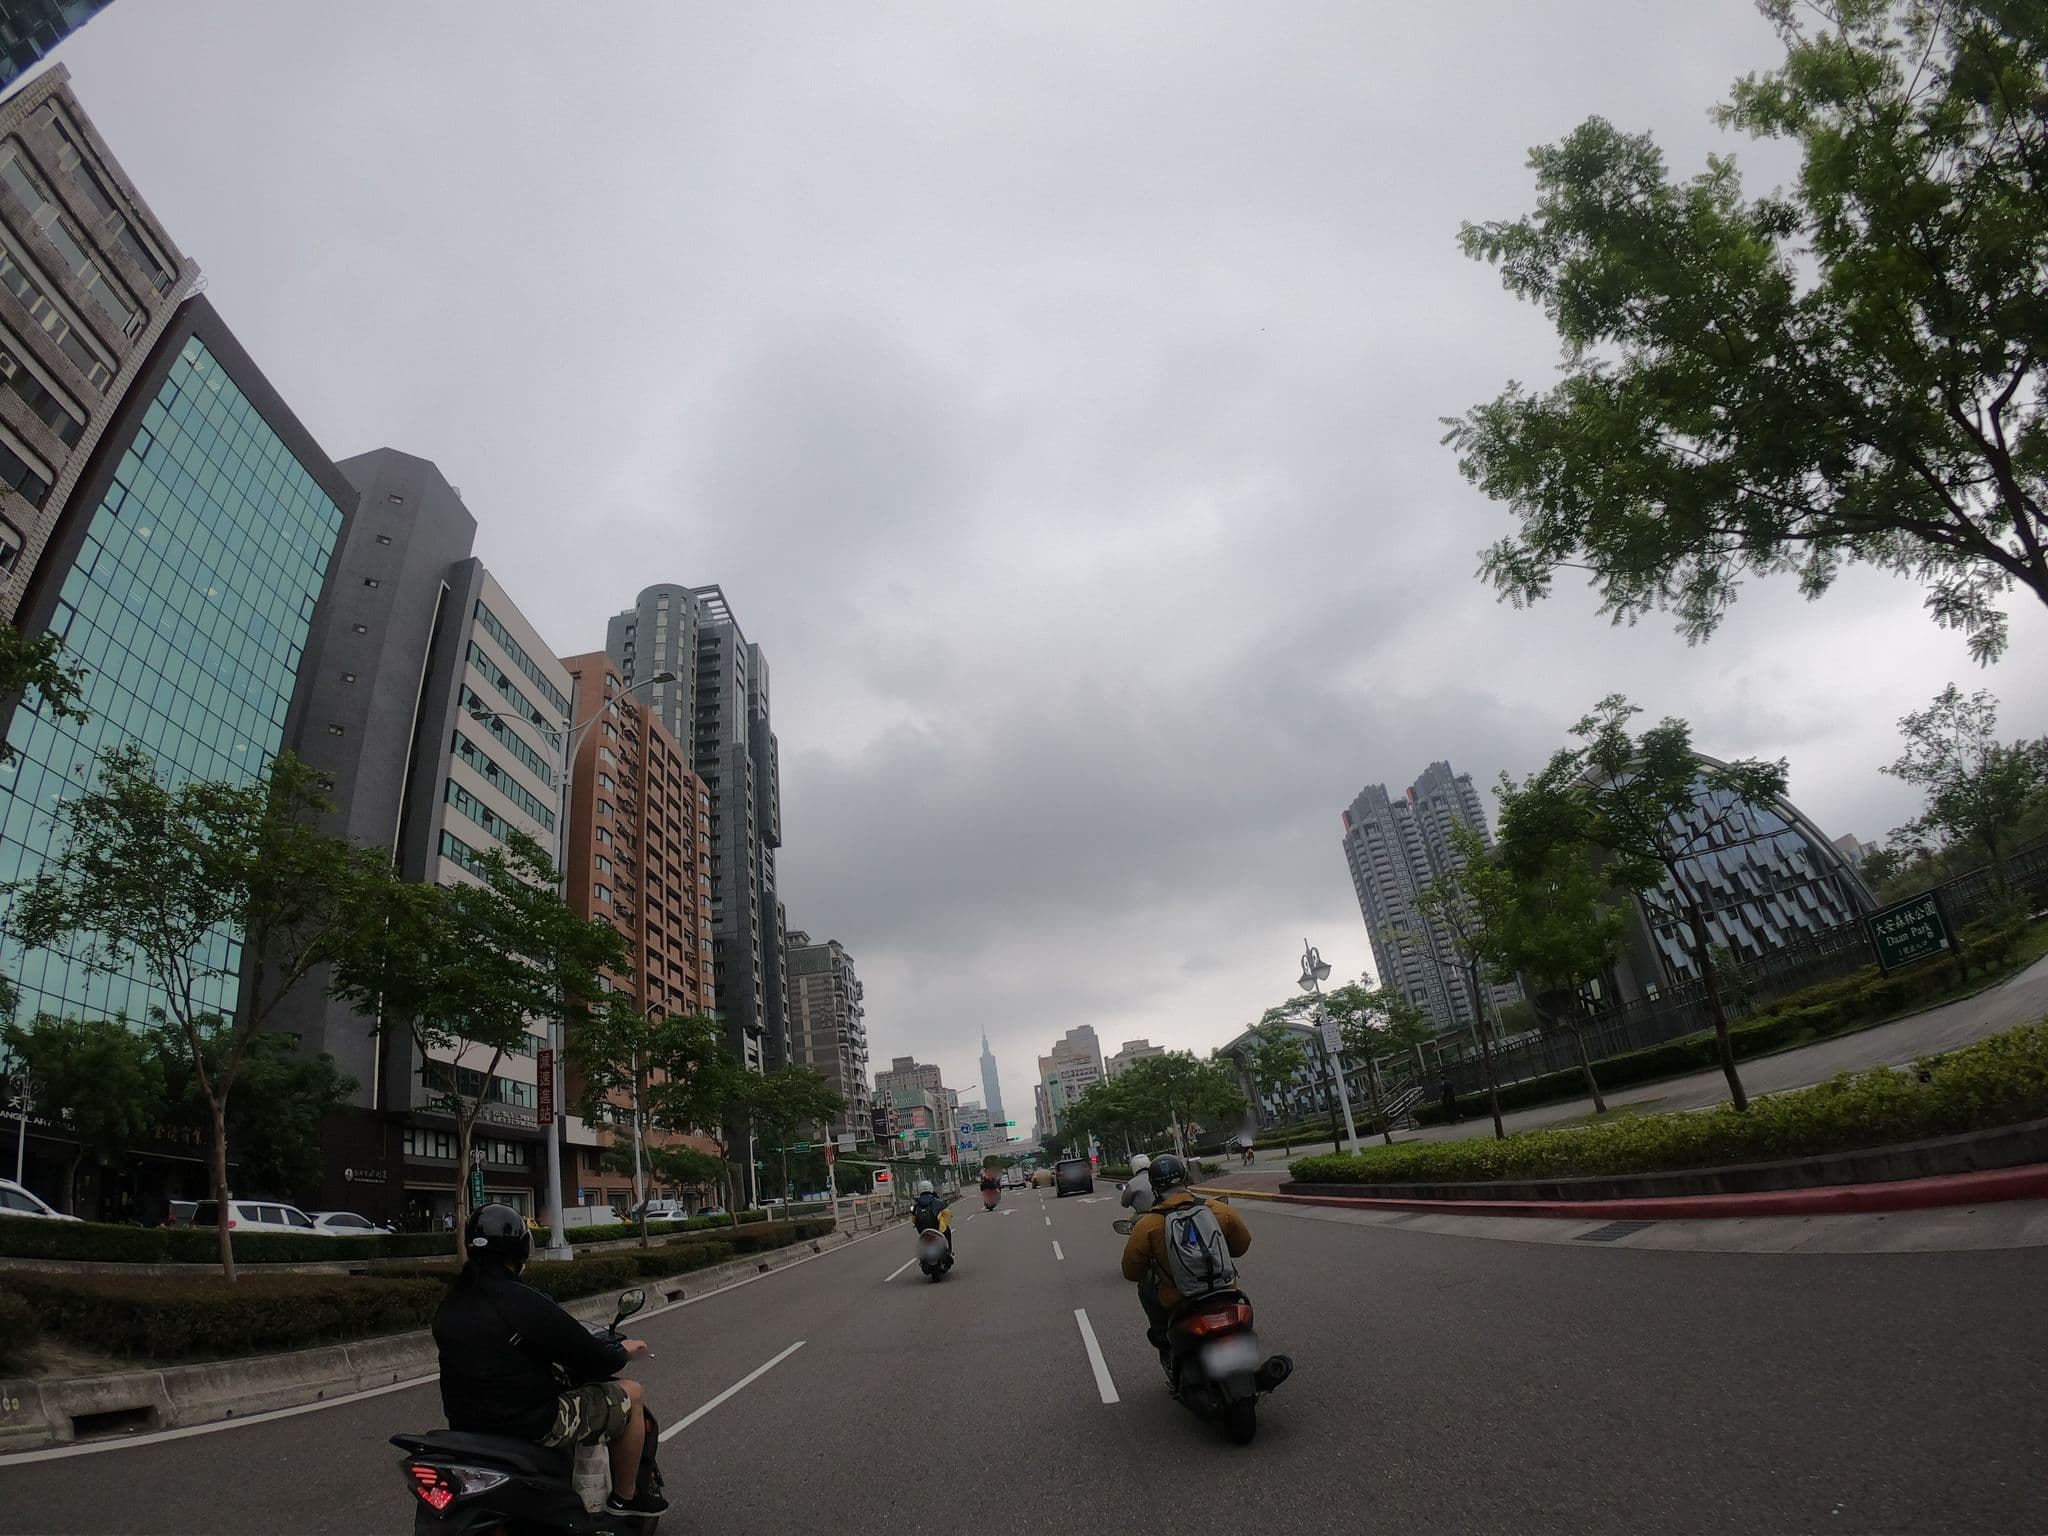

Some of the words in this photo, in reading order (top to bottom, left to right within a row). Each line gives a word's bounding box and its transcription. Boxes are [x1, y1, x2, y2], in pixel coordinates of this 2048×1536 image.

[1876, 901, 1935, 936] 大安森林公園
[1886, 933, 1909, 946] Daan
[1910, 922, 1931, 937] Park
[539, 1053, 551, 1121] 減速進站
